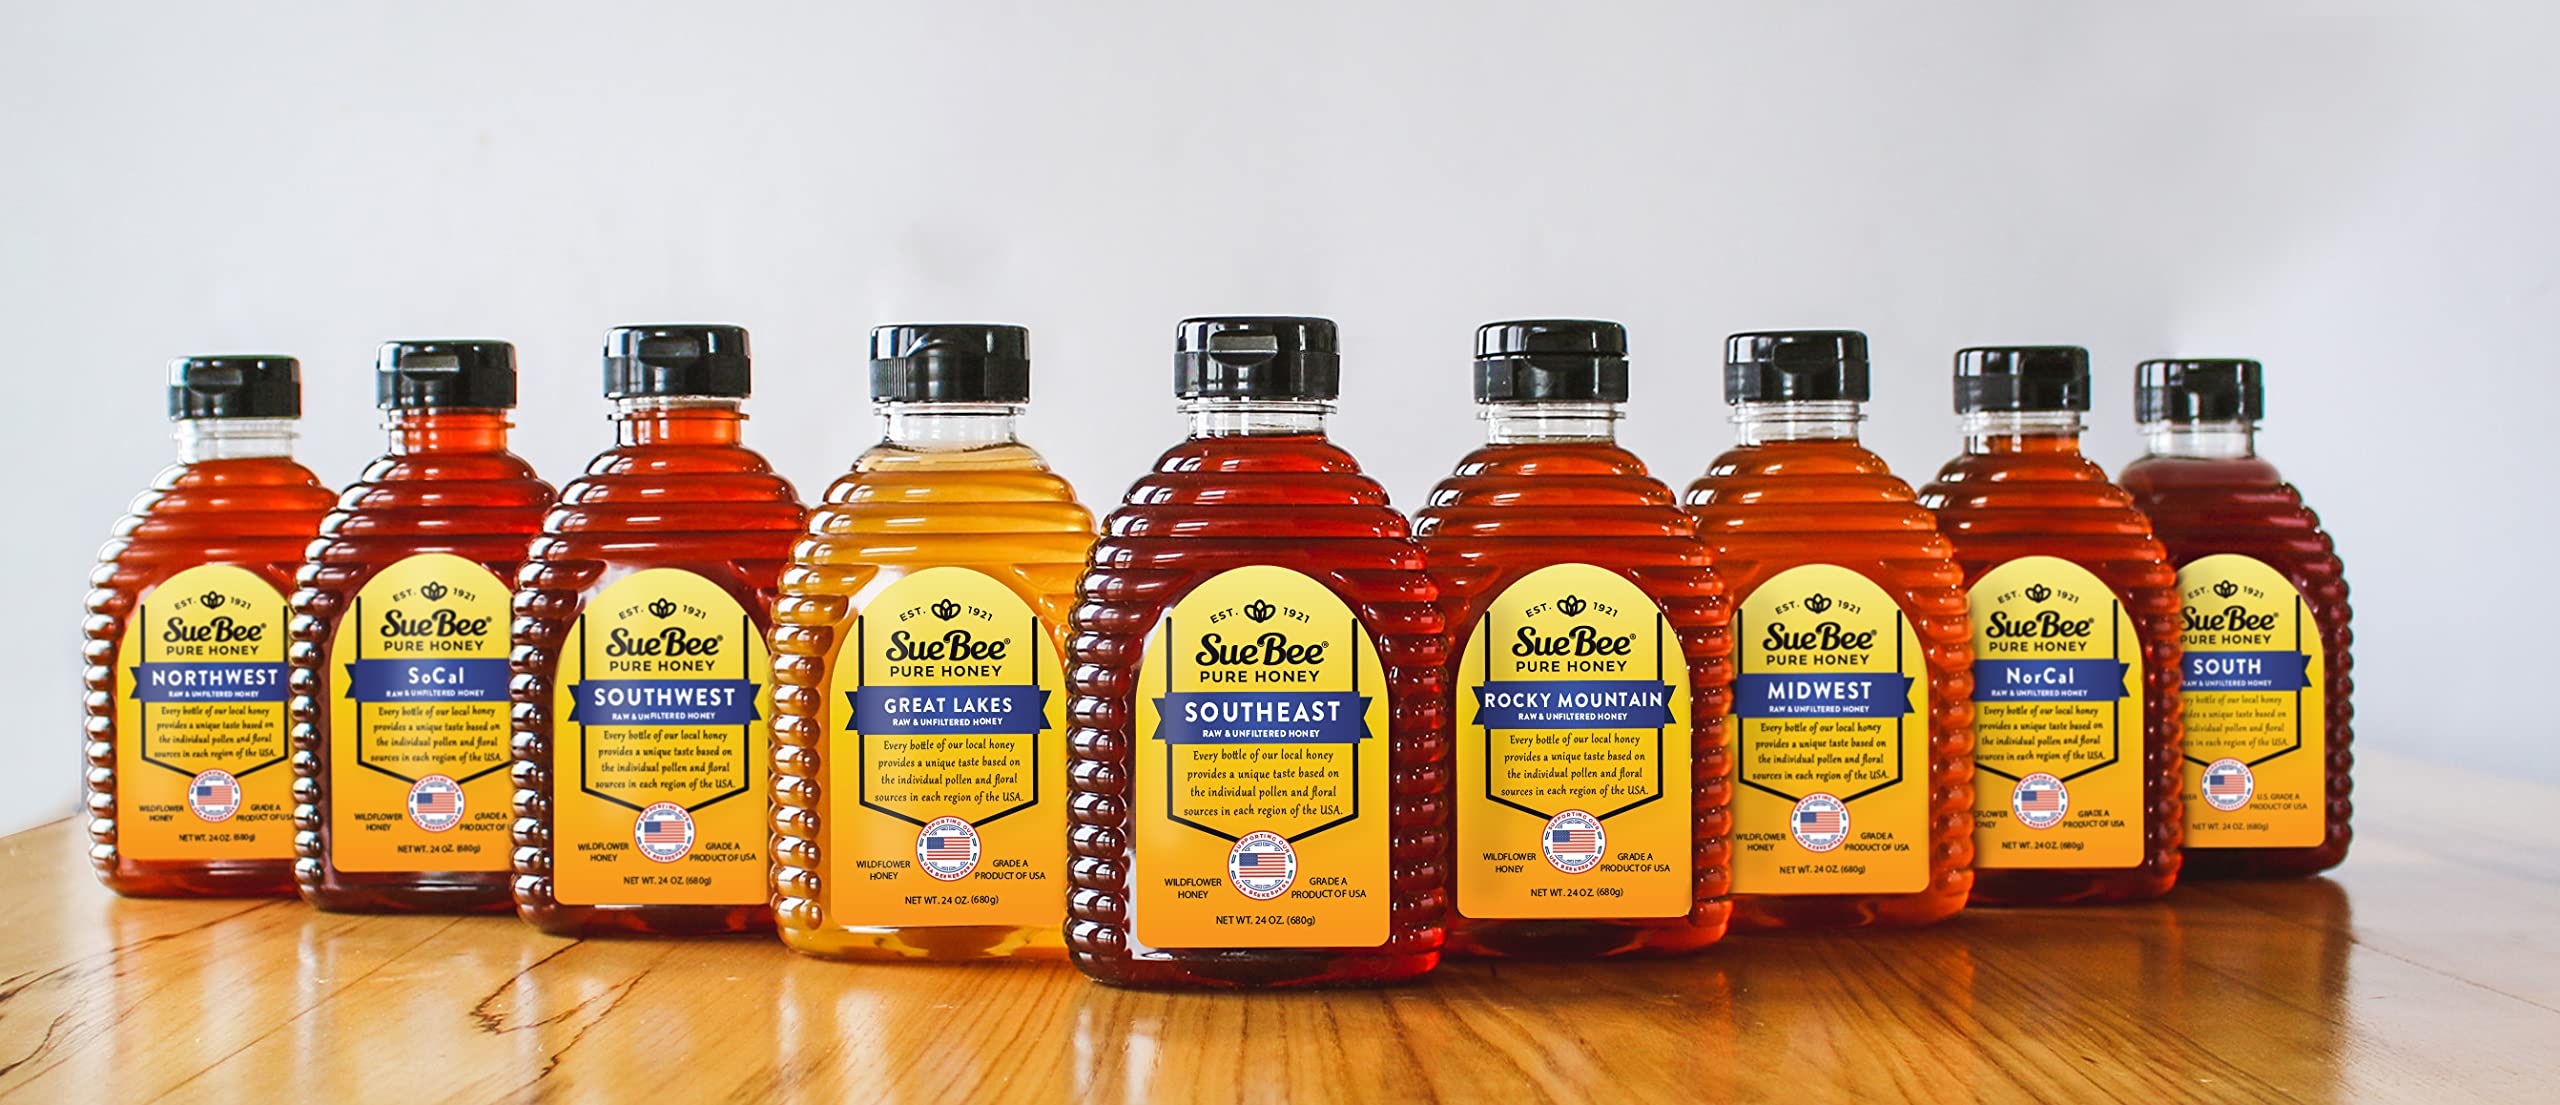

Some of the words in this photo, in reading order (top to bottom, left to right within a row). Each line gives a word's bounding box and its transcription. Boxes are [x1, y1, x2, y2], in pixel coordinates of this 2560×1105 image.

[453, 588, 476, 602] 1921
[2057, 590, 2079, 604] 1921
[230, 597, 251, 610] 1921
[1525, 603, 1551, 617] EST.
[1593, 602, 1618, 617] 1921
[1775, 601, 1799, 614] EST.
[1838, 600, 1861, 614] 1921
[618, 606, 642, 620] EST.
[682, 605, 706, 620] 1921
[900, 607, 925, 622] EST.
[968, 606, 993, 622] 1921
[1210, 608, 1238, 624] EST.
[1283, 607, 1310, 624] 1921
[2180, 635, 2216, 644] PURE
[2222, 634, 2272, 644] HONEY
[167, 646, 202, 655] PURE
[209, 646, 258, 655] HONEY
[384, 641, 423, 651] PURE
[430, 640, 484, 651] HONEY
[1990, 642, 2027, 652] PURE
[2034, 642, 2087, 652] HONEY
[610, 661, 651, 671] PURE
[658, 660, 715, 671] HONEY
[1767, 655, 1807, 665] PURE
[1814, 654, 1869, 665] HONEY
[891, 666, 934, 677] PURE
[942, 665, 1002, 677] HONEY
[1516, 661, 1559, 672] PURE
[1567, 660, 1627, 672] HONEY
[2194, 659, 2261, 674] SOUTH
[152, 670, 278, 686] NORTHWEST
[408, 667, 464, 684] SoCal
[1201, 671, 1247, 682] PURE
[1255, 670, 1319, 682] HONEY
[2007, 668, 2074, 684] NorCal
[1768, 682, 1871, 699] MIDWEST
[595, 688, 735, 706] SOUTHWEST
[1485, 693, 1551, 709] ROCKY
[1558, 692, 1662, 708] MOUNTAIN
[884, 698, 945, 714] GREAT
[954, 698, 1012, 713] LAKES
[1185, 701, 1340, 722] SOUTHEAST
[638, 712, 684, 720] UNFILTERED
[893, 718, 910, 726] RAW
[913, 718, 918, 726] &
[920, 718, 970, 726] UNFILTERED
[973, 717, 1003, 726] HONEY
[1518, 713, 1537, 721] RAW
[1538, 713, 1544, 721] &
[1546, 713, 1596, 721] UNFILTERED
[1202, 730, 1222, 738] RAW
[1225, 730, 1231, 738] &
[1232, 730, 1287, 738] UNFILTERED
[1288, 730, 1319, 738] HONEY
[1193, 749, 1218, 762] Every
[1221, 749, 1247, 760] bottle
[1250, 748, 1260, 764] of
[1263, 751, 1278, 760] our
[1281, 749, 1302, 760] local
[1306, 749, 1333, 763] honey
[1187, 768, 1226, 782] provides
[1238, 768, 1270, 782] unique
[1273, 769, 1295, 778] taste
[1298, 767, 1324, 778] based
[1328, 770, 1339, 778] on
[1190, 786, 1205, 797] the
[1208, 786, 1256, 797] individual
[1259, 786, 1288, 800] pollen
[1291, 786, 1309, 797] and
[1311, 785, 1336, 800] floral
[1184, 807, 1218, 817] sources
[1221, 805, 1231, 816] in
[1234, 804, 1255, 815] each
[1258, 806, 1286, 819] region
[1290, 803, 1301, 818] of
[1302, 804, 1317, 815] the
[1320, 804, 1342, 815] USA.
[857, 860, 910, 868] WILDFLOWER
[993, 859, 1019, 867] GRADE
[1021, 859, 1028, 867] A
[869, 871, 898, 879] HONEY
[975, 871, 1013, 880] PRODUCT
[1015, 871, 1027, 879] OF
[1029, 871, 1045, 879] USA
[1309, 877, 1338, 885] GRADE
[1340, 877, 1347, 885] A
[1164, 878, 1221, 886] WILDFLOWER
[1178, 890, 1208, 899] HONEY
[1291, 890, 1333, 899] PRODUCT
[1334, 889, 1347, 898] OF
[1349, 889, 1367, 898] USA
[905, 896, 921, 904] NET
[923, 896, 940, 904] WT.
[942, 896, 953, 904] 24
[955, 896, 969, 904] OZ.
[971, 895, 998, 906] (680g)
[1216, 916, 1233, 925] NET
[1235, 916, 1253, 925] WT.
[1255, 916, 1268, 925] 24
[1269, 916, 1284, 925] OZ.
[1287, 915, 1315, 927] (680g)
